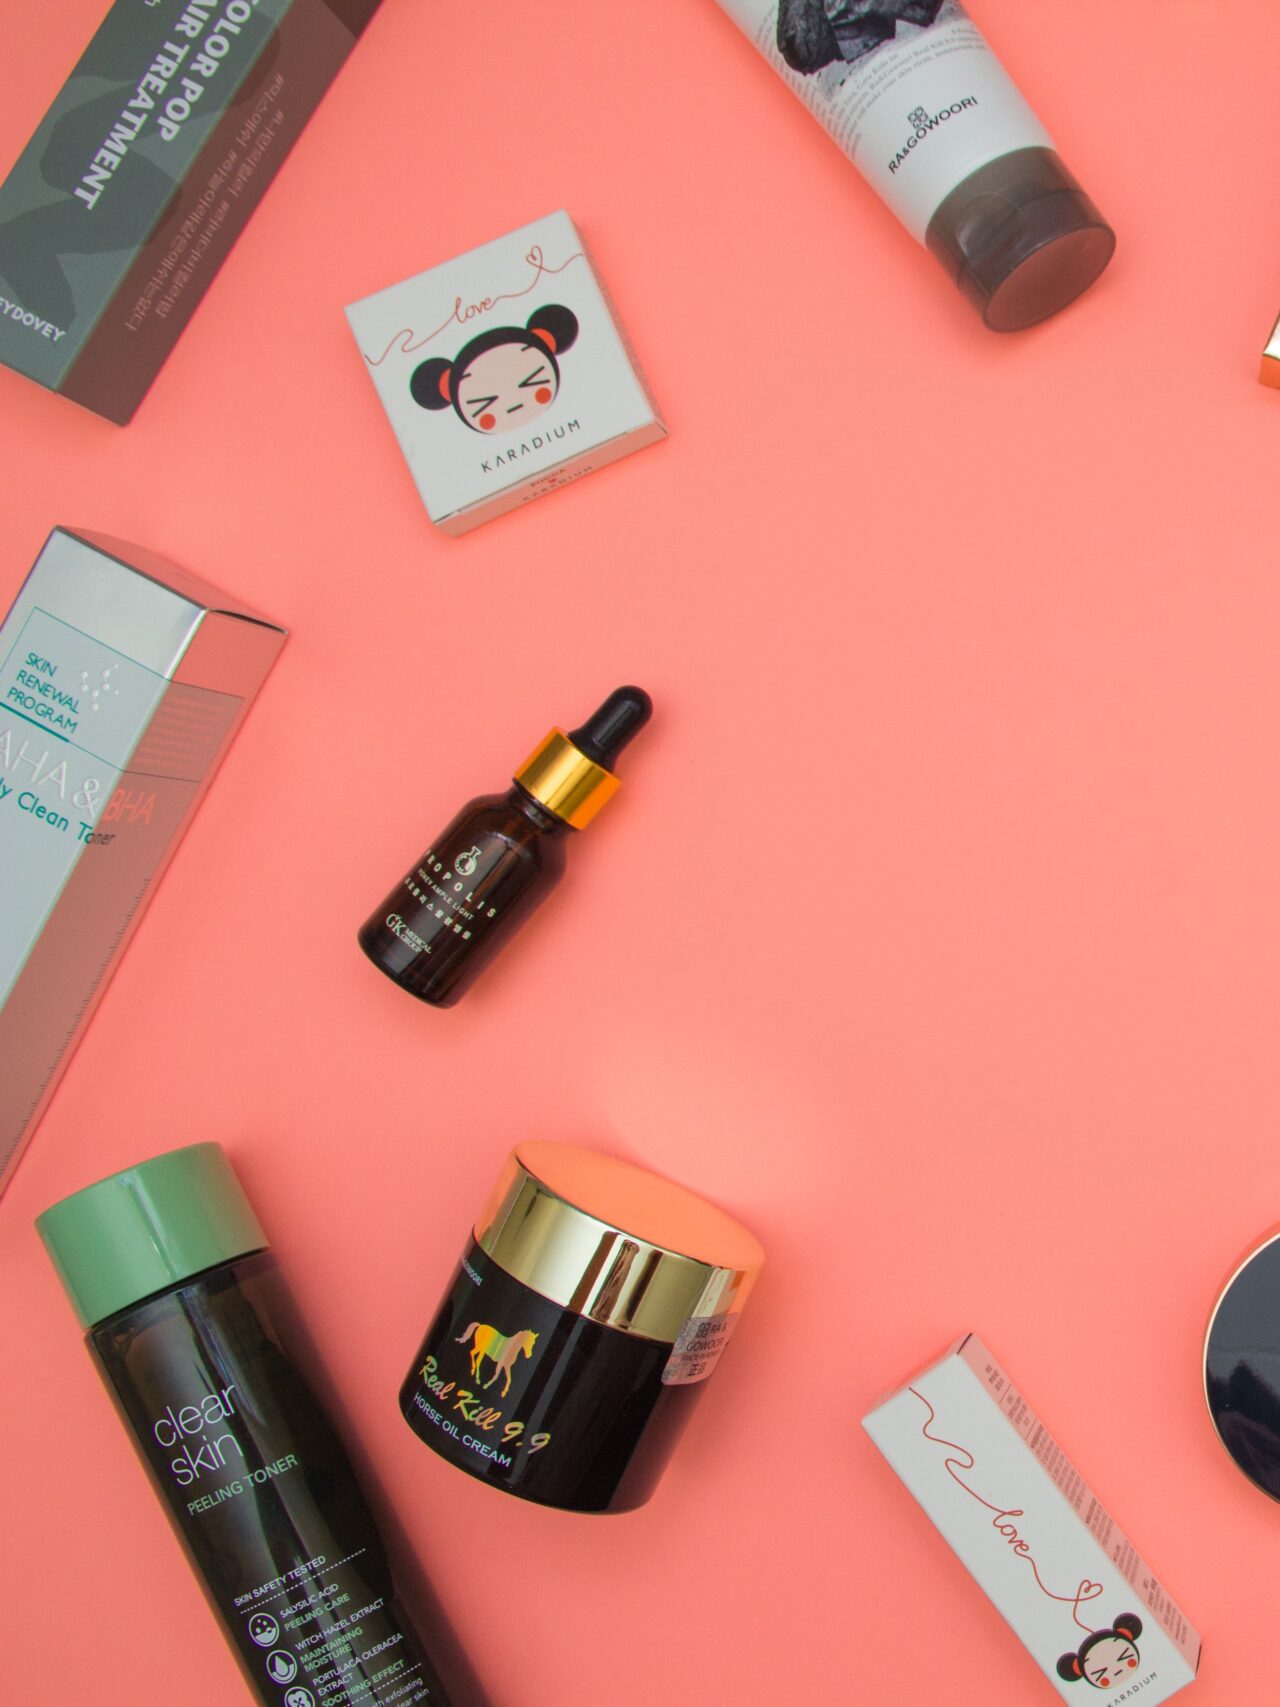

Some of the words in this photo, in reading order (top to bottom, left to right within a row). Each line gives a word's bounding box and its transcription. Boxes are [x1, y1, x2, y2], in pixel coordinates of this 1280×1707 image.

[190, 0, 259, 77] OLOR
[74, 41, 190, 210] TREATMENT
[157, 77, 204, 141] POP
[888, 96, 978, 174] RA&GOWOORI
[455, 297, 493, 323] love
[481, 419, 581, 473] KARADIUM
[25, 652, 57, 677] SKIN
[6, 687, 78, 734] PROGRAM
[16, 669, 81, 715] RENEWAL
[18, 791, 70, 832] Clean
[77, 821, 116, 845] Toner
[72, 777, 101, 819] &
[103, 788, 157, 825] BHA
[432, 883, 453, 905] AMPLE
[453, 902, 475, 921] LIGHT
[400, 934, 423, 953] GROUP
[404, 927, 433, 954] MEDICAL
[155, 1385, 234, 1446] clear
[419, 1354, 457, 1401] Real
[452, 1389, 502, 1431] Kill
[503, 1421, 551, 1455] 9.9
[413, 1391, 441, 1427] HORSE
[442, 1419, 460, 1441] OIL
[462, 1432, 512, 1468] CREAM
[171, 1434, 243, 1486] skin
[187, 1481, 244, 1516] PEELING
[243, 1454, 299, 1487] TONER
[992, 1509, 1030, 1555] love
[234, 1592, 253, 1607] SKIN
[252, 1574, 287, 1598] SAFETY
[287, 1555, 326, 1580] TESTED
[317, 1583, 339, 1599] ACID
[284, 1608, 324, 1632] PEELING
[324, 1593, 350, 1611] CARE
[295, 1631, 323, 1651] WITCH
[324, 1619, 350, 1636] HAZEL
[350, 1598, 384, 1622] EXTRACT
[300, 1627, 364, 1665] MAINTAINING
[304, 1644, 351, 1672] MOISTURE
[312, 1657, 362, 1687] PORTULACA
[362, 1633, 404, 1661] OLERACEA
[318, 1673, 354, 1697] EXTRACT
[321, 1680, 371, 1707] SOOTHING
[371, 1659, 406, 1683] EFFECT
[385, 1677, 424, 1703] exfoliating
[413, 1688, 430, 1701] skin
[1106, 1671, 1158, 1707] KARADIUM
